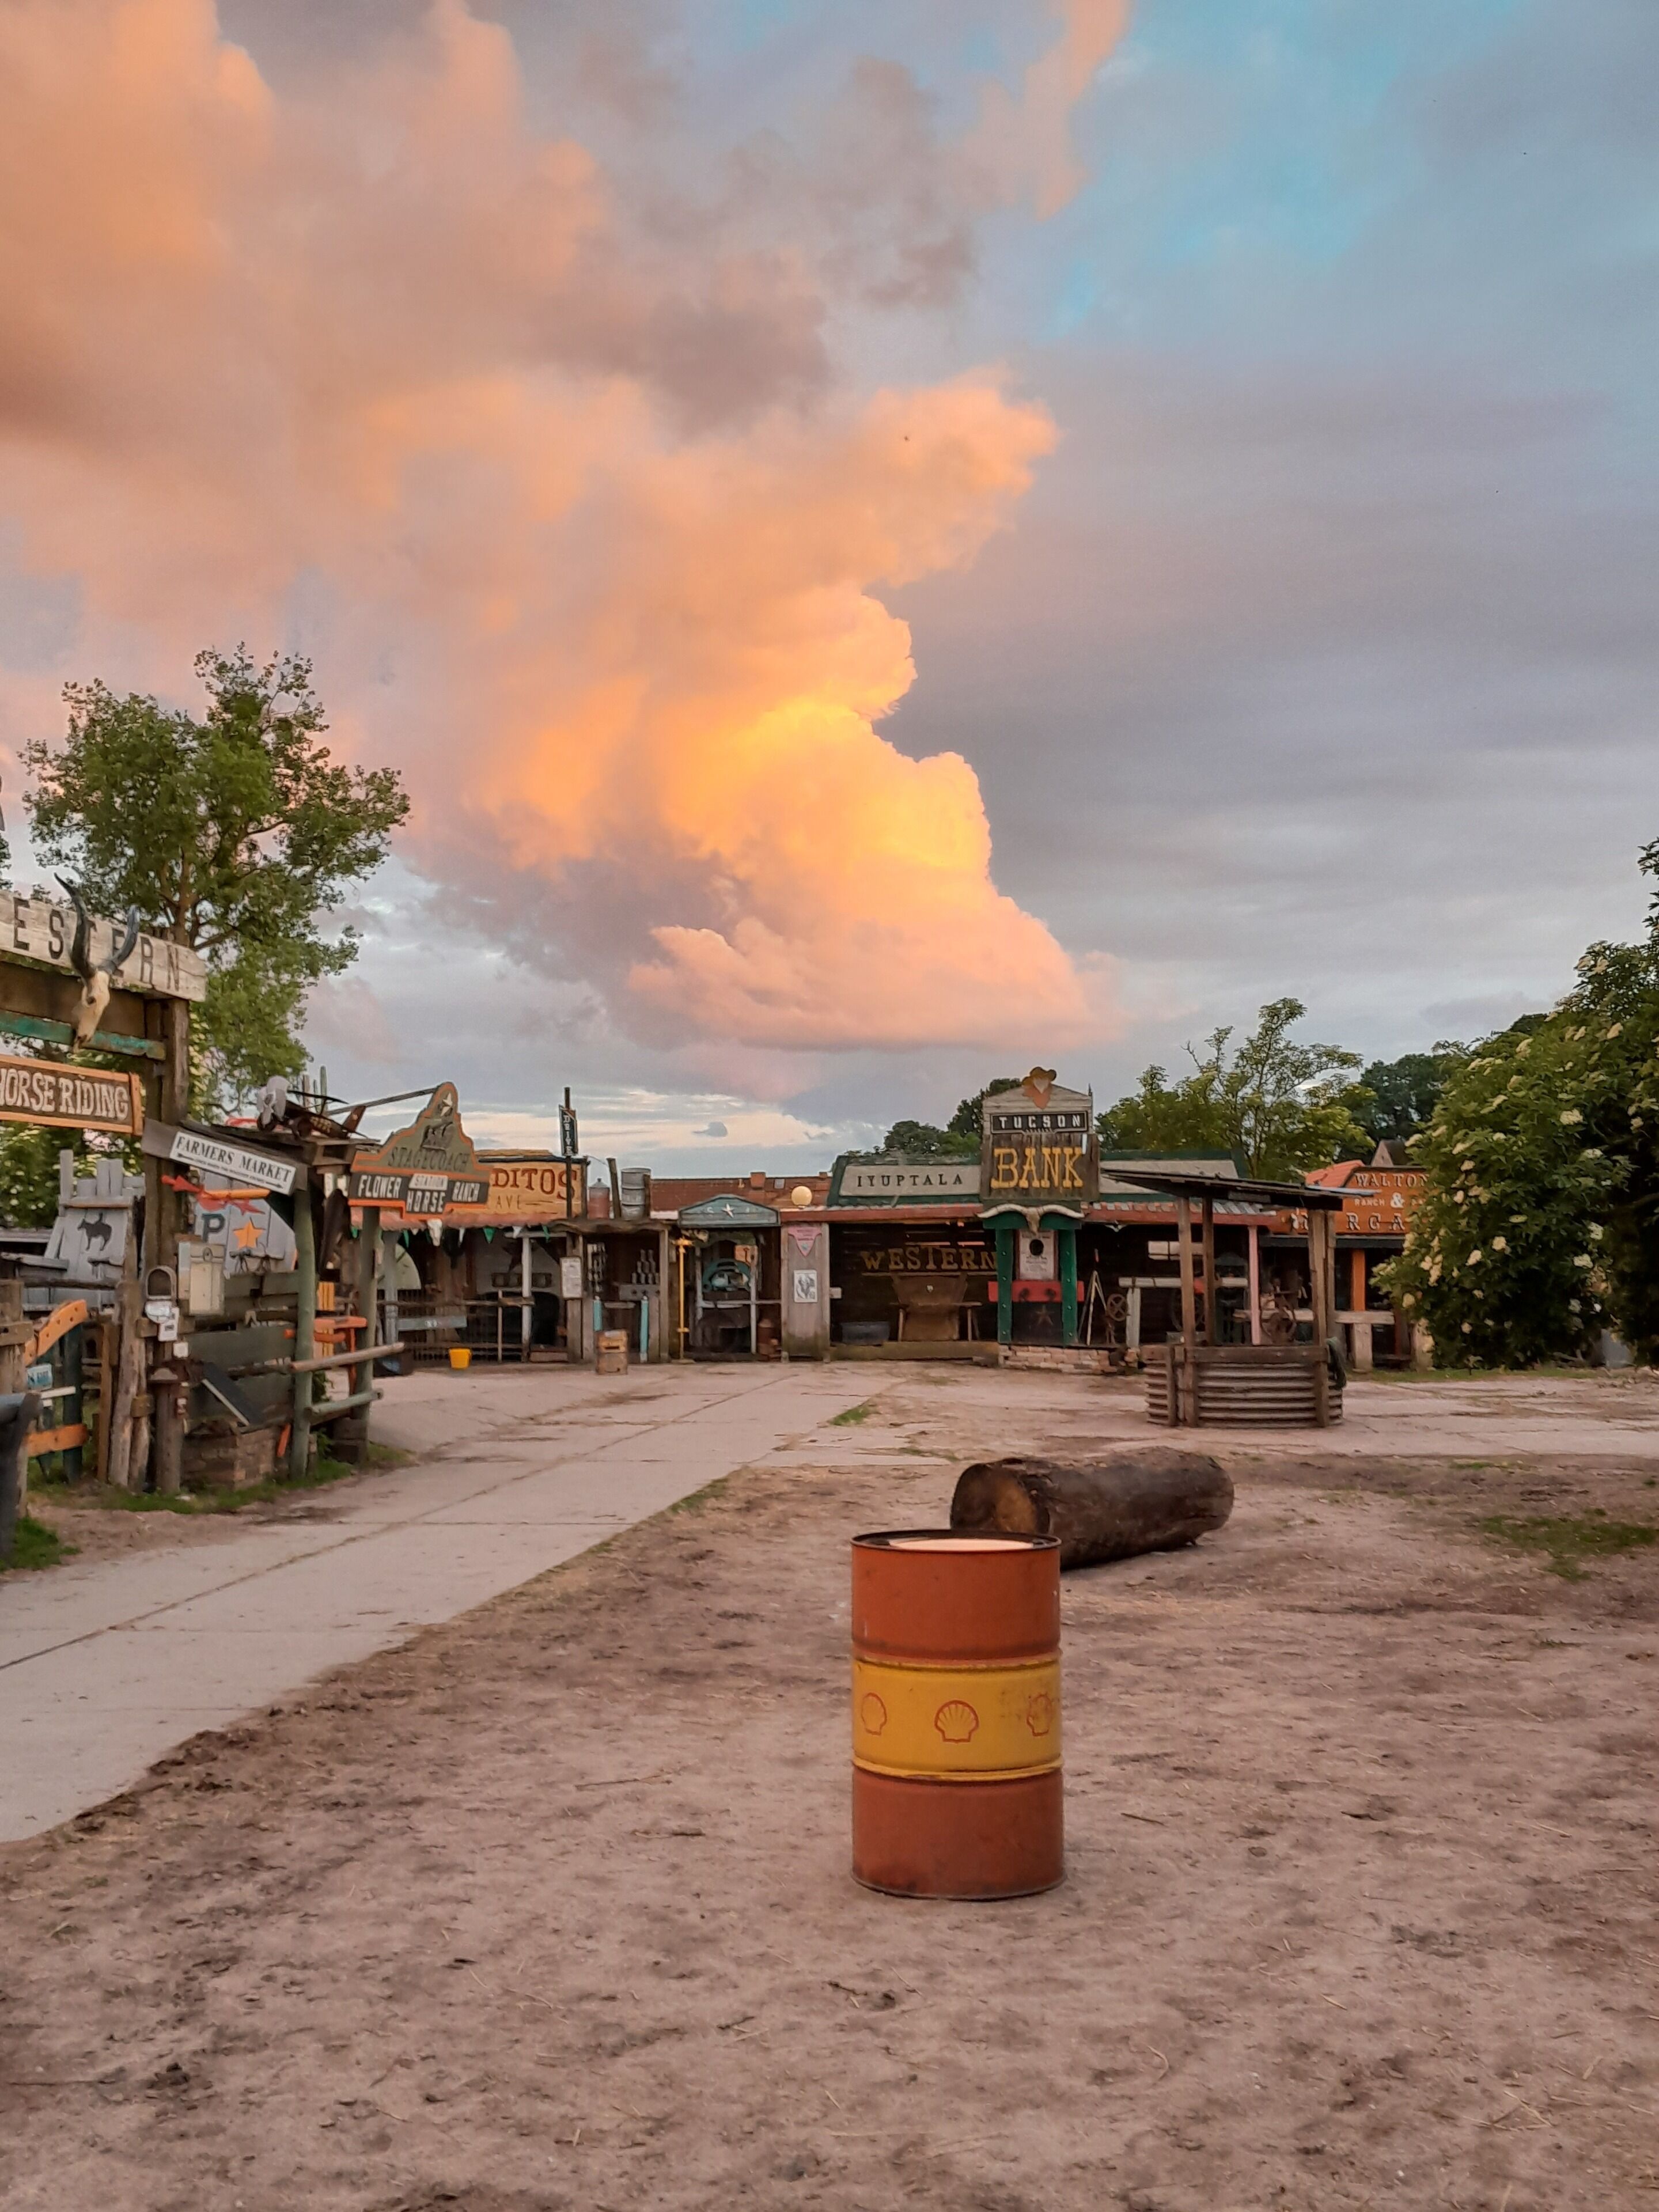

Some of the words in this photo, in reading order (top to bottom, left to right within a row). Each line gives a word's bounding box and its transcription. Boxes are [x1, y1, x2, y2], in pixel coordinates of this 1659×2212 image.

[59, 1077, 128, 1120] RIDING
[999, 1115, 1081, 1129] TUCSON
[176, 1136, 235, 1165] FARMERS
[240, 1156, 292, 1183] MARKET
[388, 1147, 470, 1173] STAGECOACH
[990, 1147, 1084, 1189] BANK
[358, 1175, 402, 1198] FLOWER
[452, 1182, 480, 1202] RANCH
[857, 1173, 963, 1187] IYUPTALA
[406, 1190, 445, 1213] HORSE
[1354, 1198, 1385, 1207] RANCH
[1390, 1192, 1406, 1209] &
[202, 1214, 225, 1243] P
[860, 1245, 997, 1270] WESTERN
